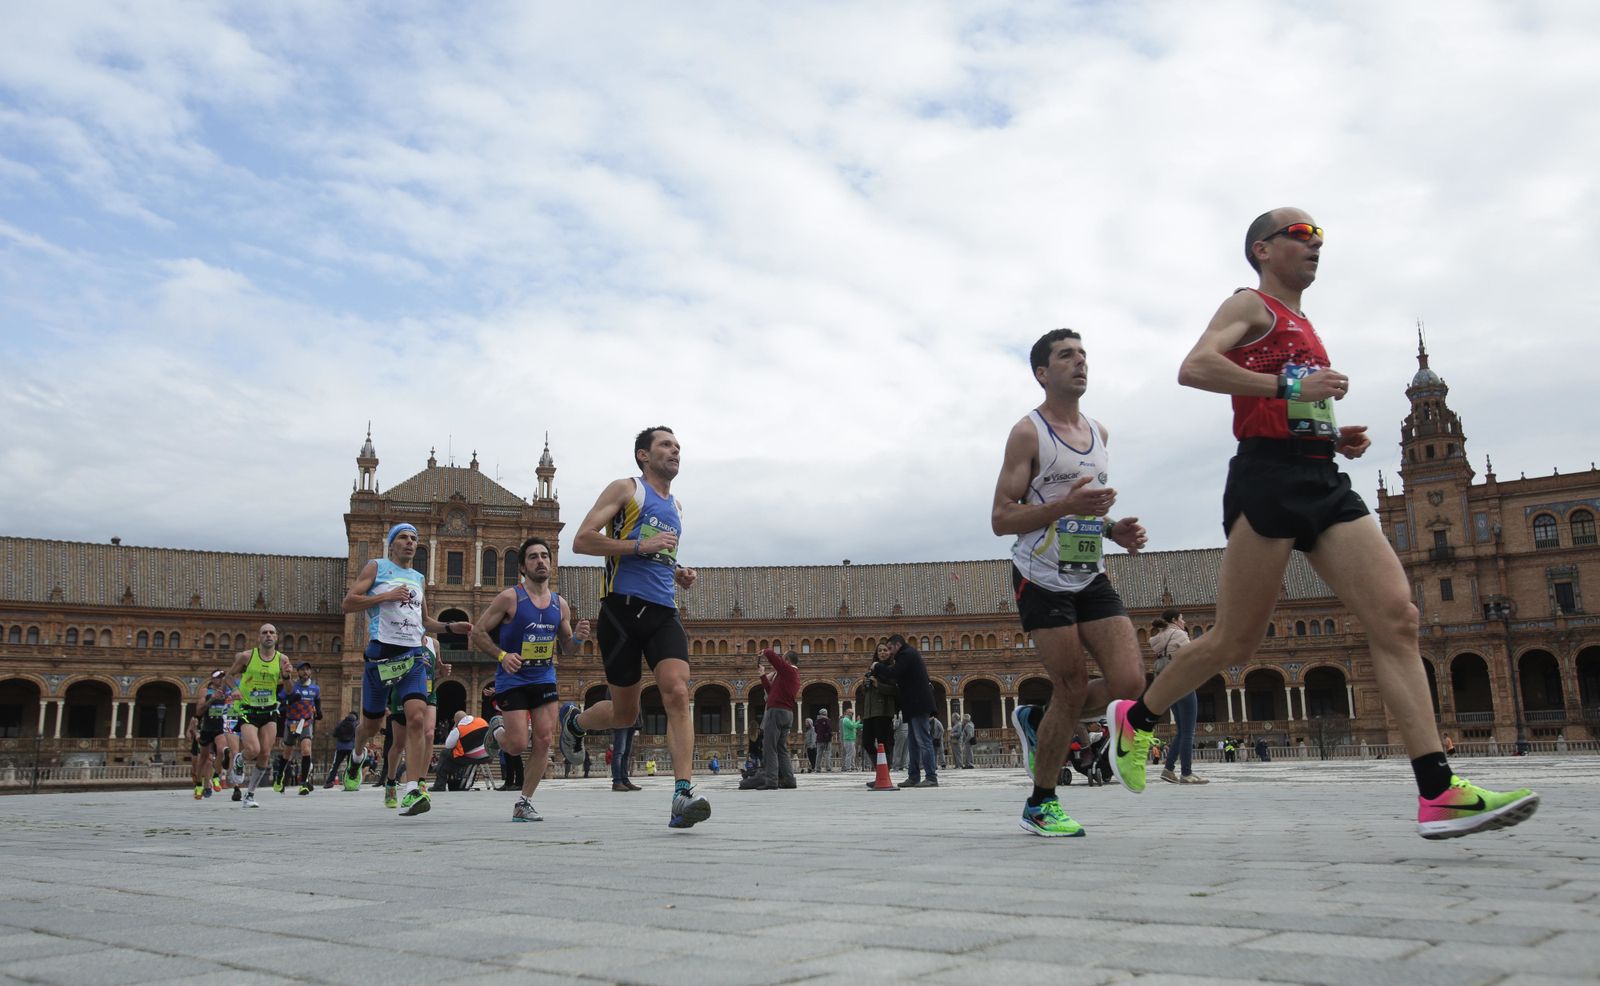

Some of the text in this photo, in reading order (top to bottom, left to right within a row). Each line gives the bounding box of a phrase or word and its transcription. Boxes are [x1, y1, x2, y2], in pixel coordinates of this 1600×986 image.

[1051, 472, 1078, 481] Visacar
[1080, 524, 1101, 532] ZURIC
[1078, 541, 1096, 552] 676
